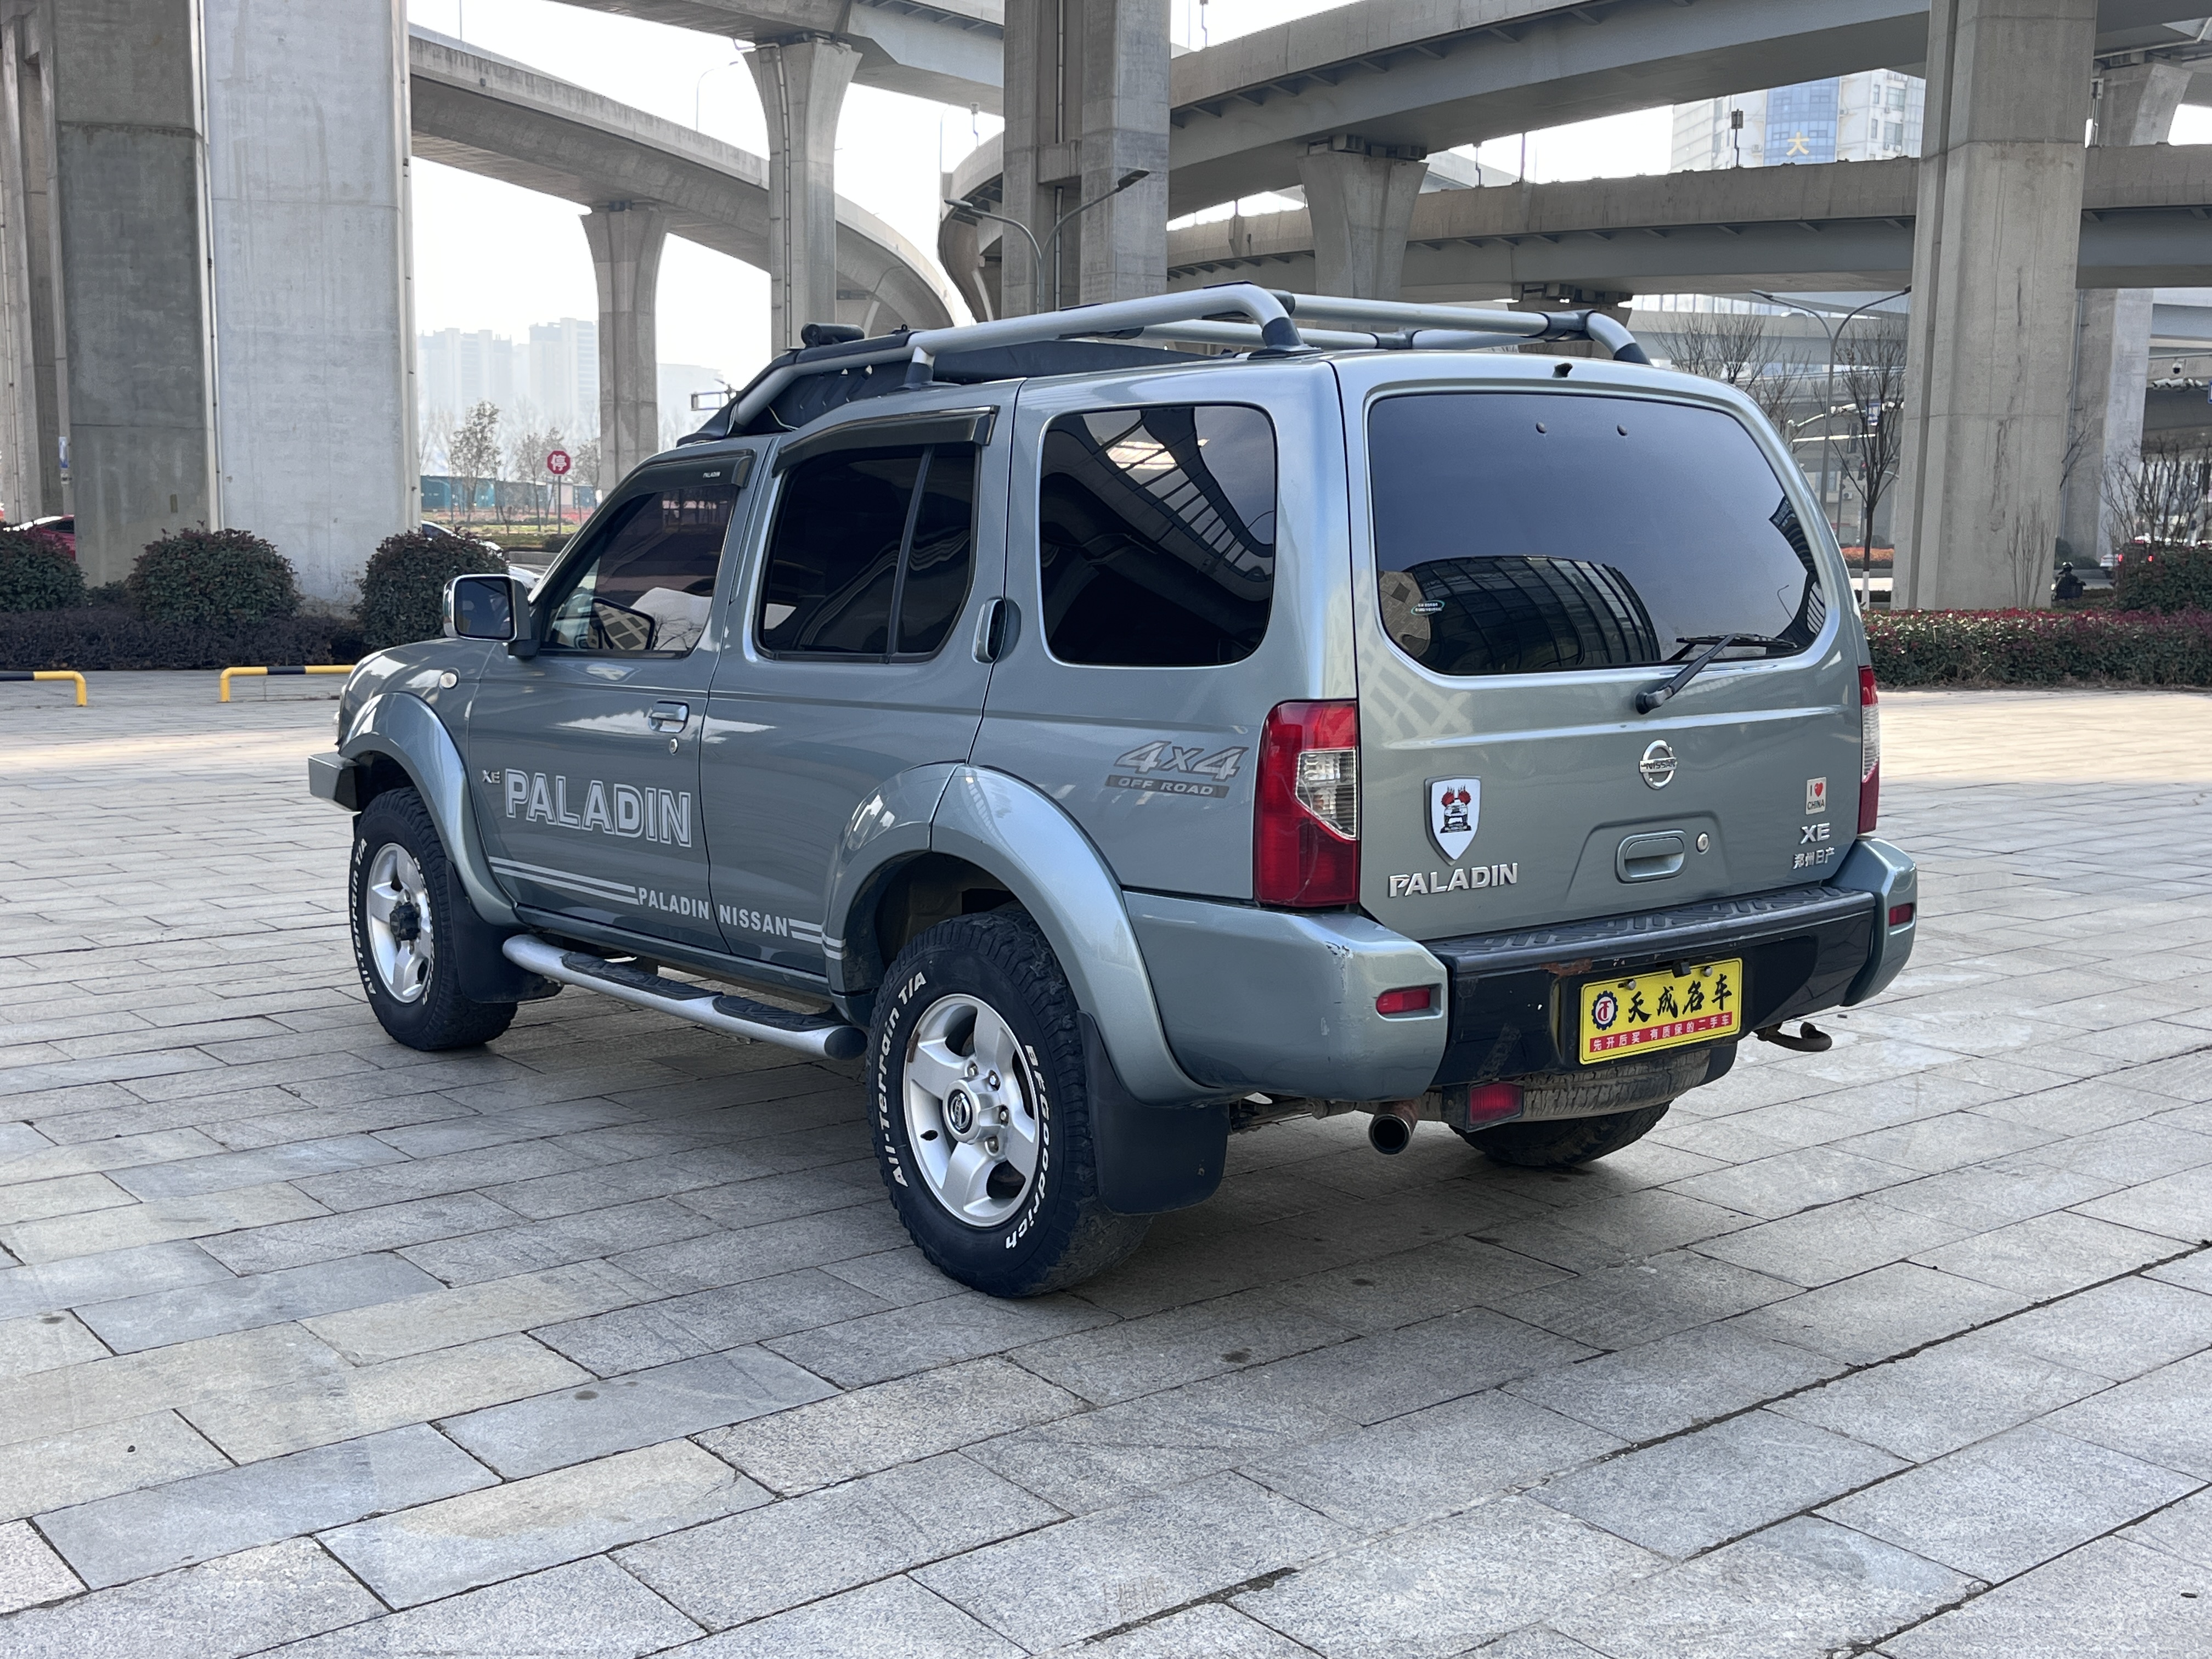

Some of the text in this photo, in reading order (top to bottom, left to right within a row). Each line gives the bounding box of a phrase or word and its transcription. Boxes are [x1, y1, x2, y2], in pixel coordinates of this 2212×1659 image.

[1786, 131, 1810, 157] 大
[550, 454, 567, 471] 停
[482, 770, 500, 784] XE
[1118, 778, 1214, 795] OFF ROAD
[505, 769, 692, 848] PALADIN
[1807, 799, 1825, 810] CHINA
[1800, 822, 1830, 844] XE
[1793, 847, 1835, 870] 郑州日产
[1389, 862, 1518, 898] PALADIN
[638, 887, 790, 937] PALADIN NISSAN
[1628, 973, 1732, 1024] 天成名车
[878, 1007, 909, 1187] All-Terrain
[1006, 1045, 1049, 1249] BFGoodrich
